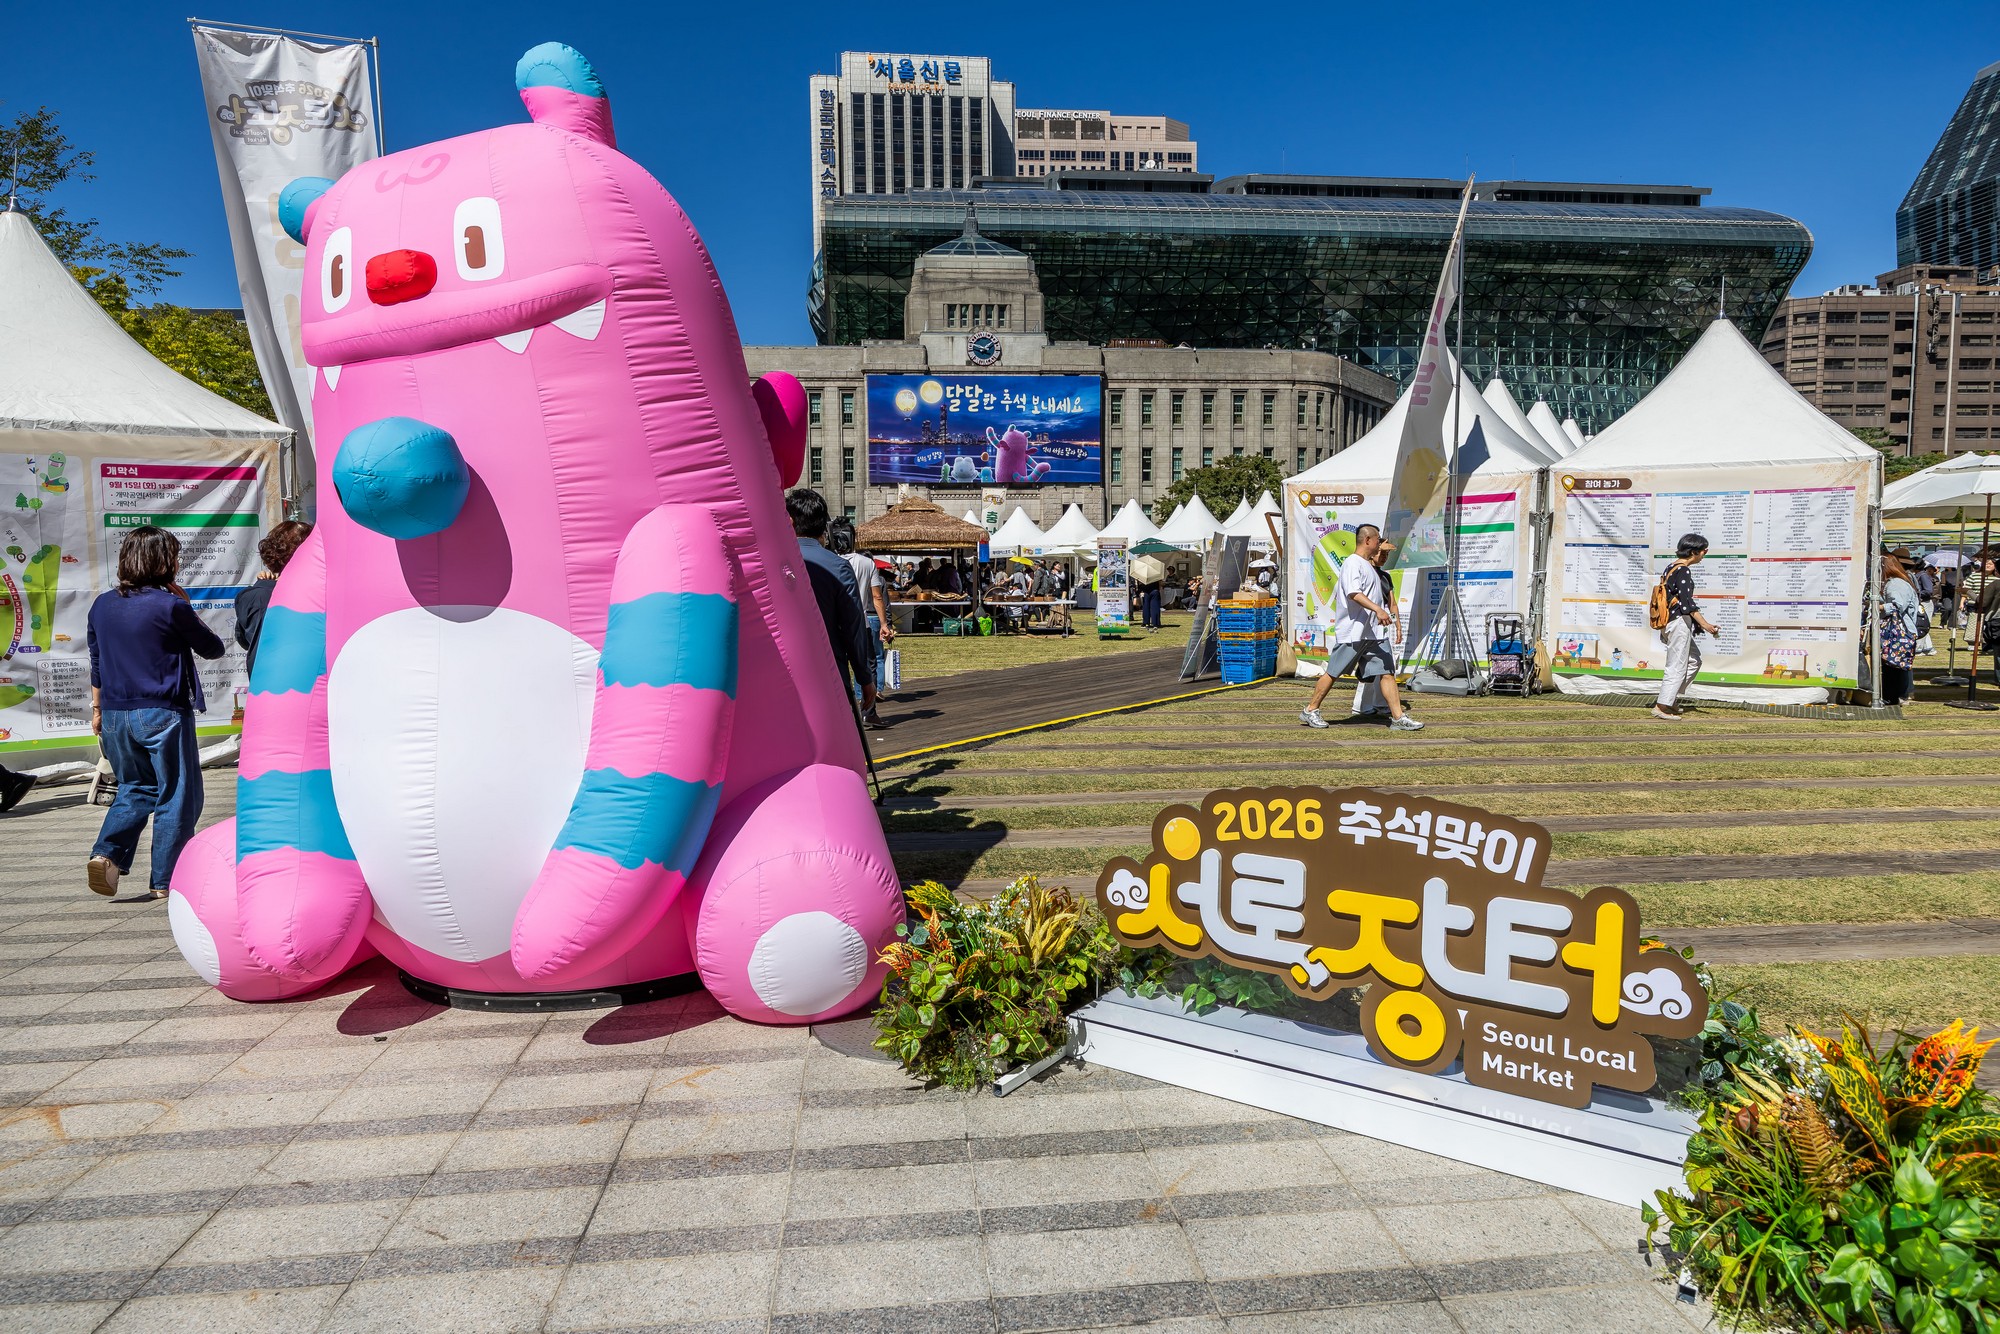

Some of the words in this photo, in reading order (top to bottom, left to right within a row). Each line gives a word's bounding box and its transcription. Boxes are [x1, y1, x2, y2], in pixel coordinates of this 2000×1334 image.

[874, 58, 961, 81] 서울신문
[888, 82, 944, 91] seoul.co.kr
[946, 384, 996, 412] 달달한
[1001, 389, 1026, 412] 추석
[1032, 395, 1084, 414] 보내세요
[106, 466, 138, 476] 개막식
[1585, 480, 1601, 488] 참여
[1603, 480, 1620, 488] 농가
[110, 516, 152, 525] 메인무대
[1212, 798, 1324, 842] 2026
[1338, 800, 1536, 883] 추석맞이
[1482, 1021, 1554, 1056] Seoul
[1562, 1037, 1638, 1074] Local
[1482, 1052, 1576, 1092] Market
